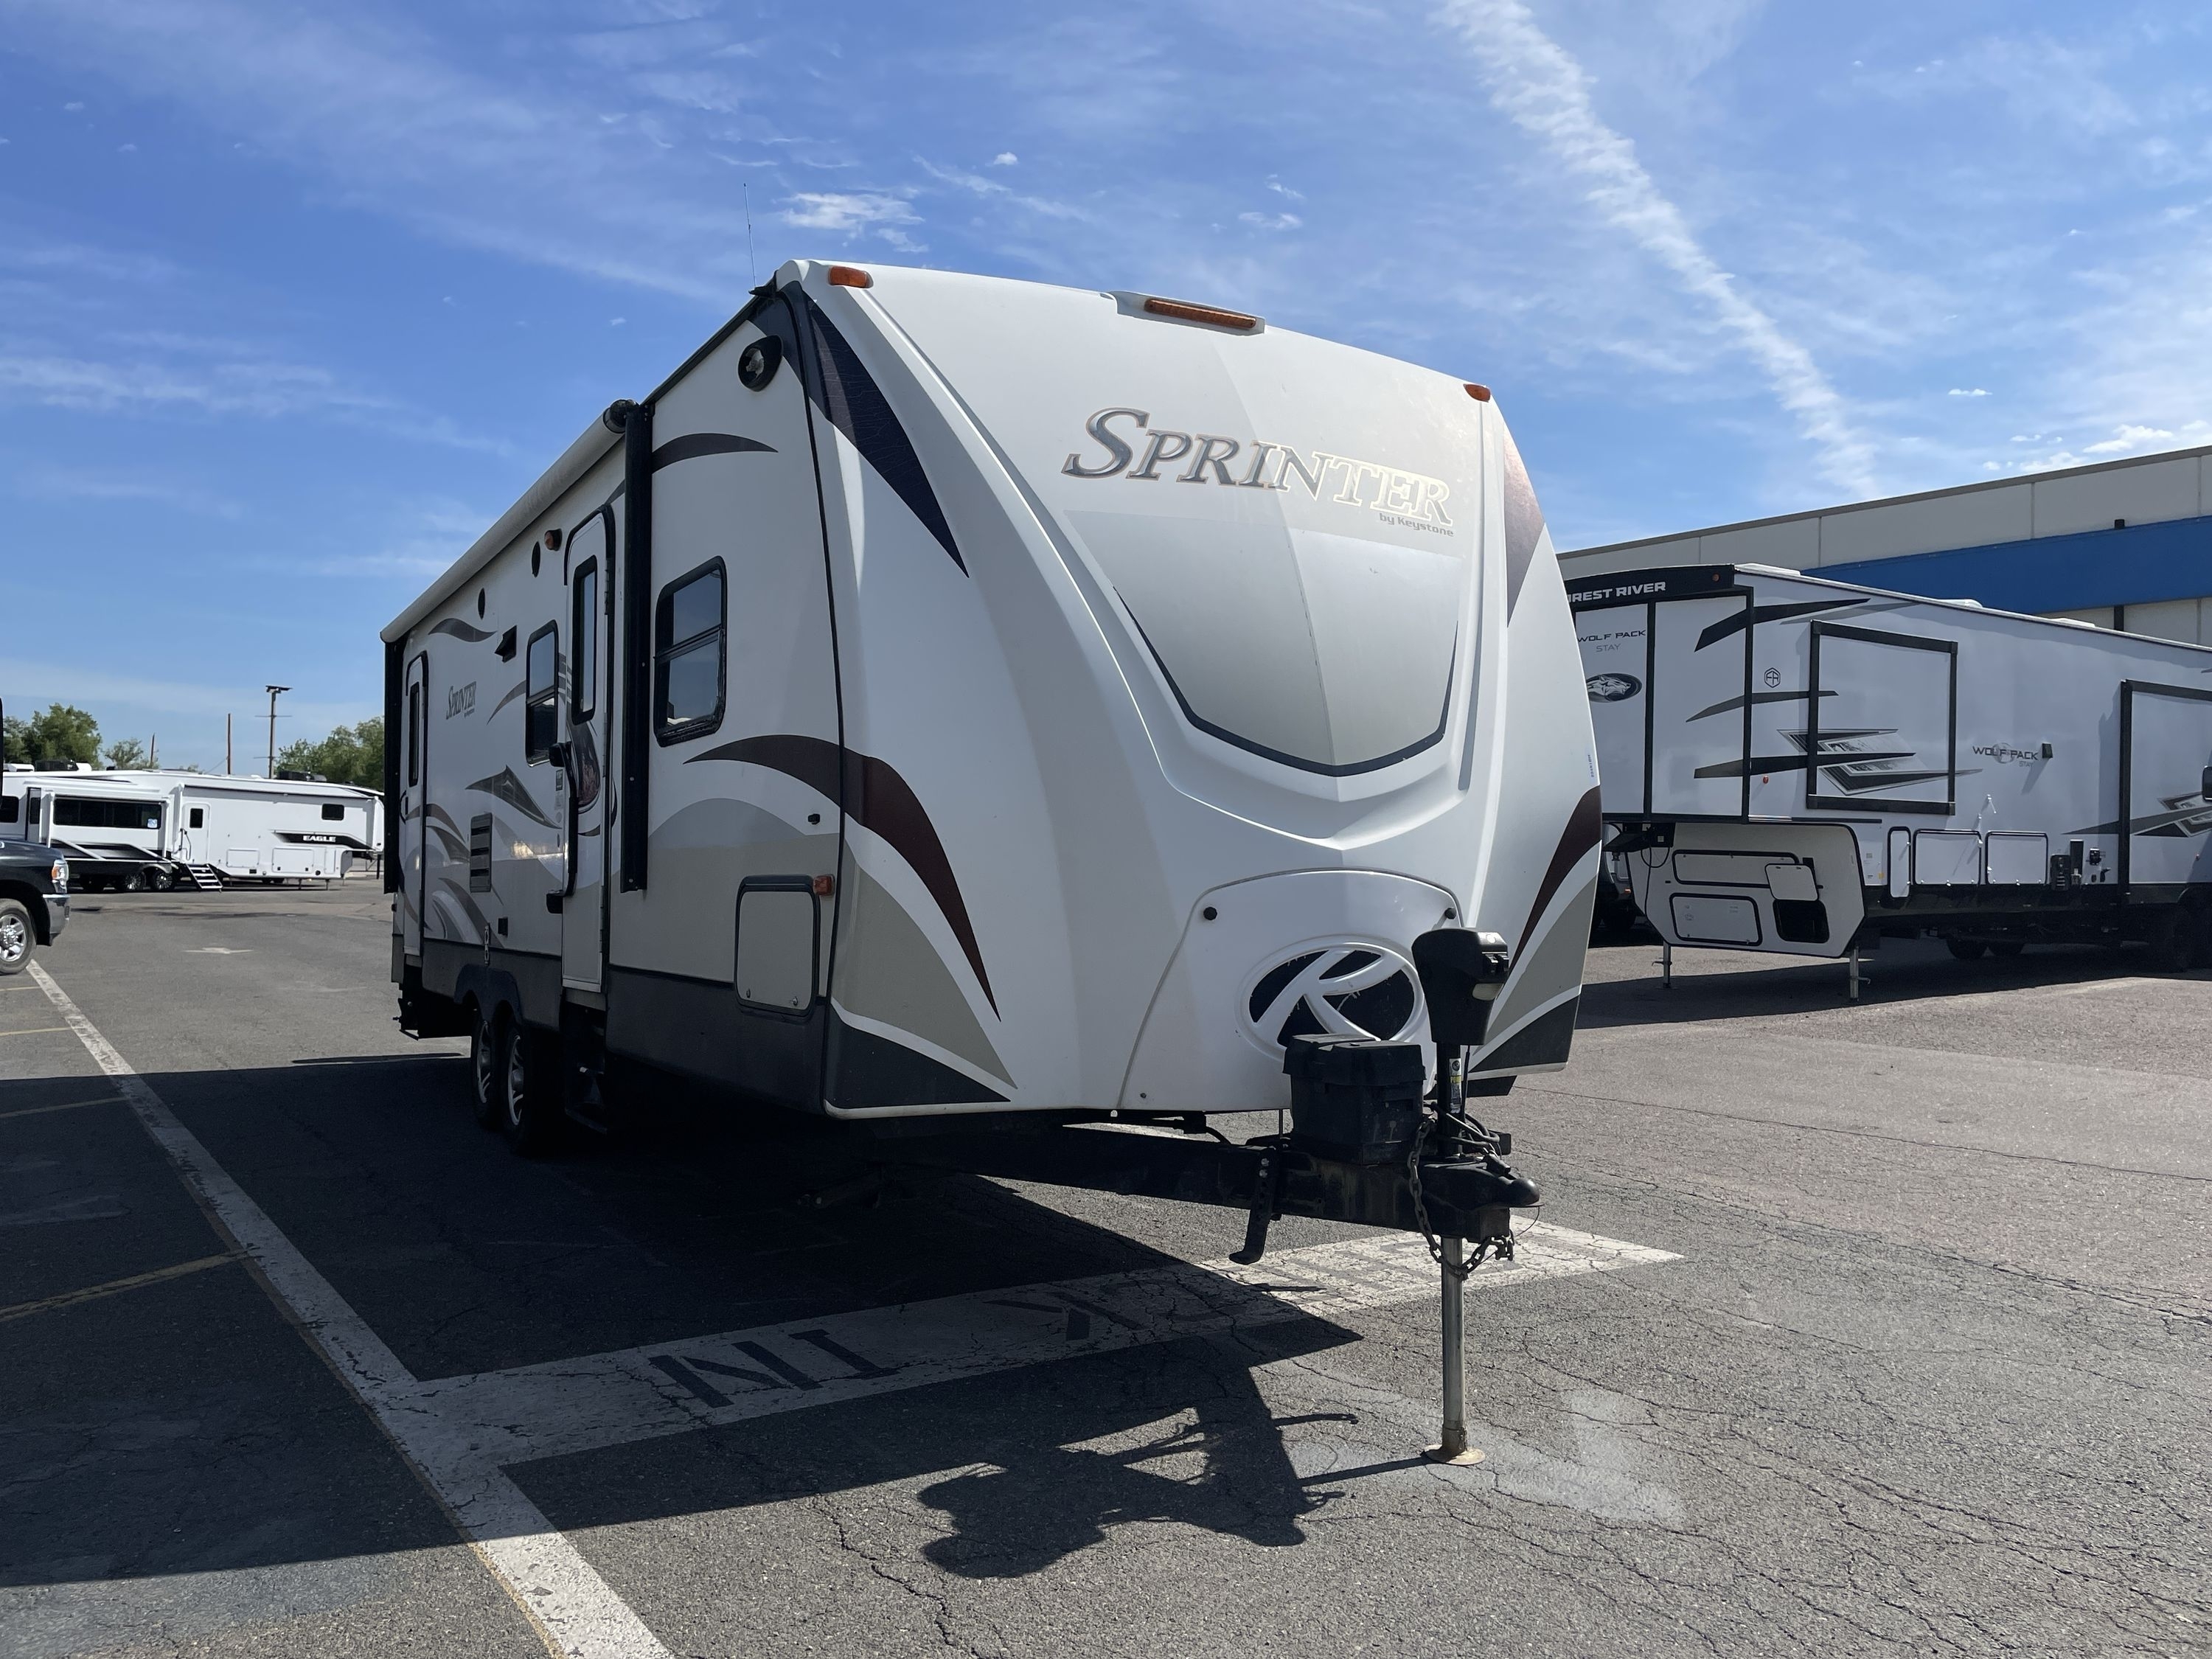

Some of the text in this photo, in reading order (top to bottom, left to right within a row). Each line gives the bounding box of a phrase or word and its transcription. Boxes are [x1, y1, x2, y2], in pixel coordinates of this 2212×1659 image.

[1061, 407, 1453, 526] SPRINTER
[1380, 513, 1454, 537] by Keystone
[1567, 581, 1666, 602] REST RIVER
[1578, 630, 1646, 642] WOLF PACK
[1596, 643, 1621, 653] STAY
[1972, 746, 2038, 761] WOLF PACK
[302, 835, 337, 843] EAGLE
